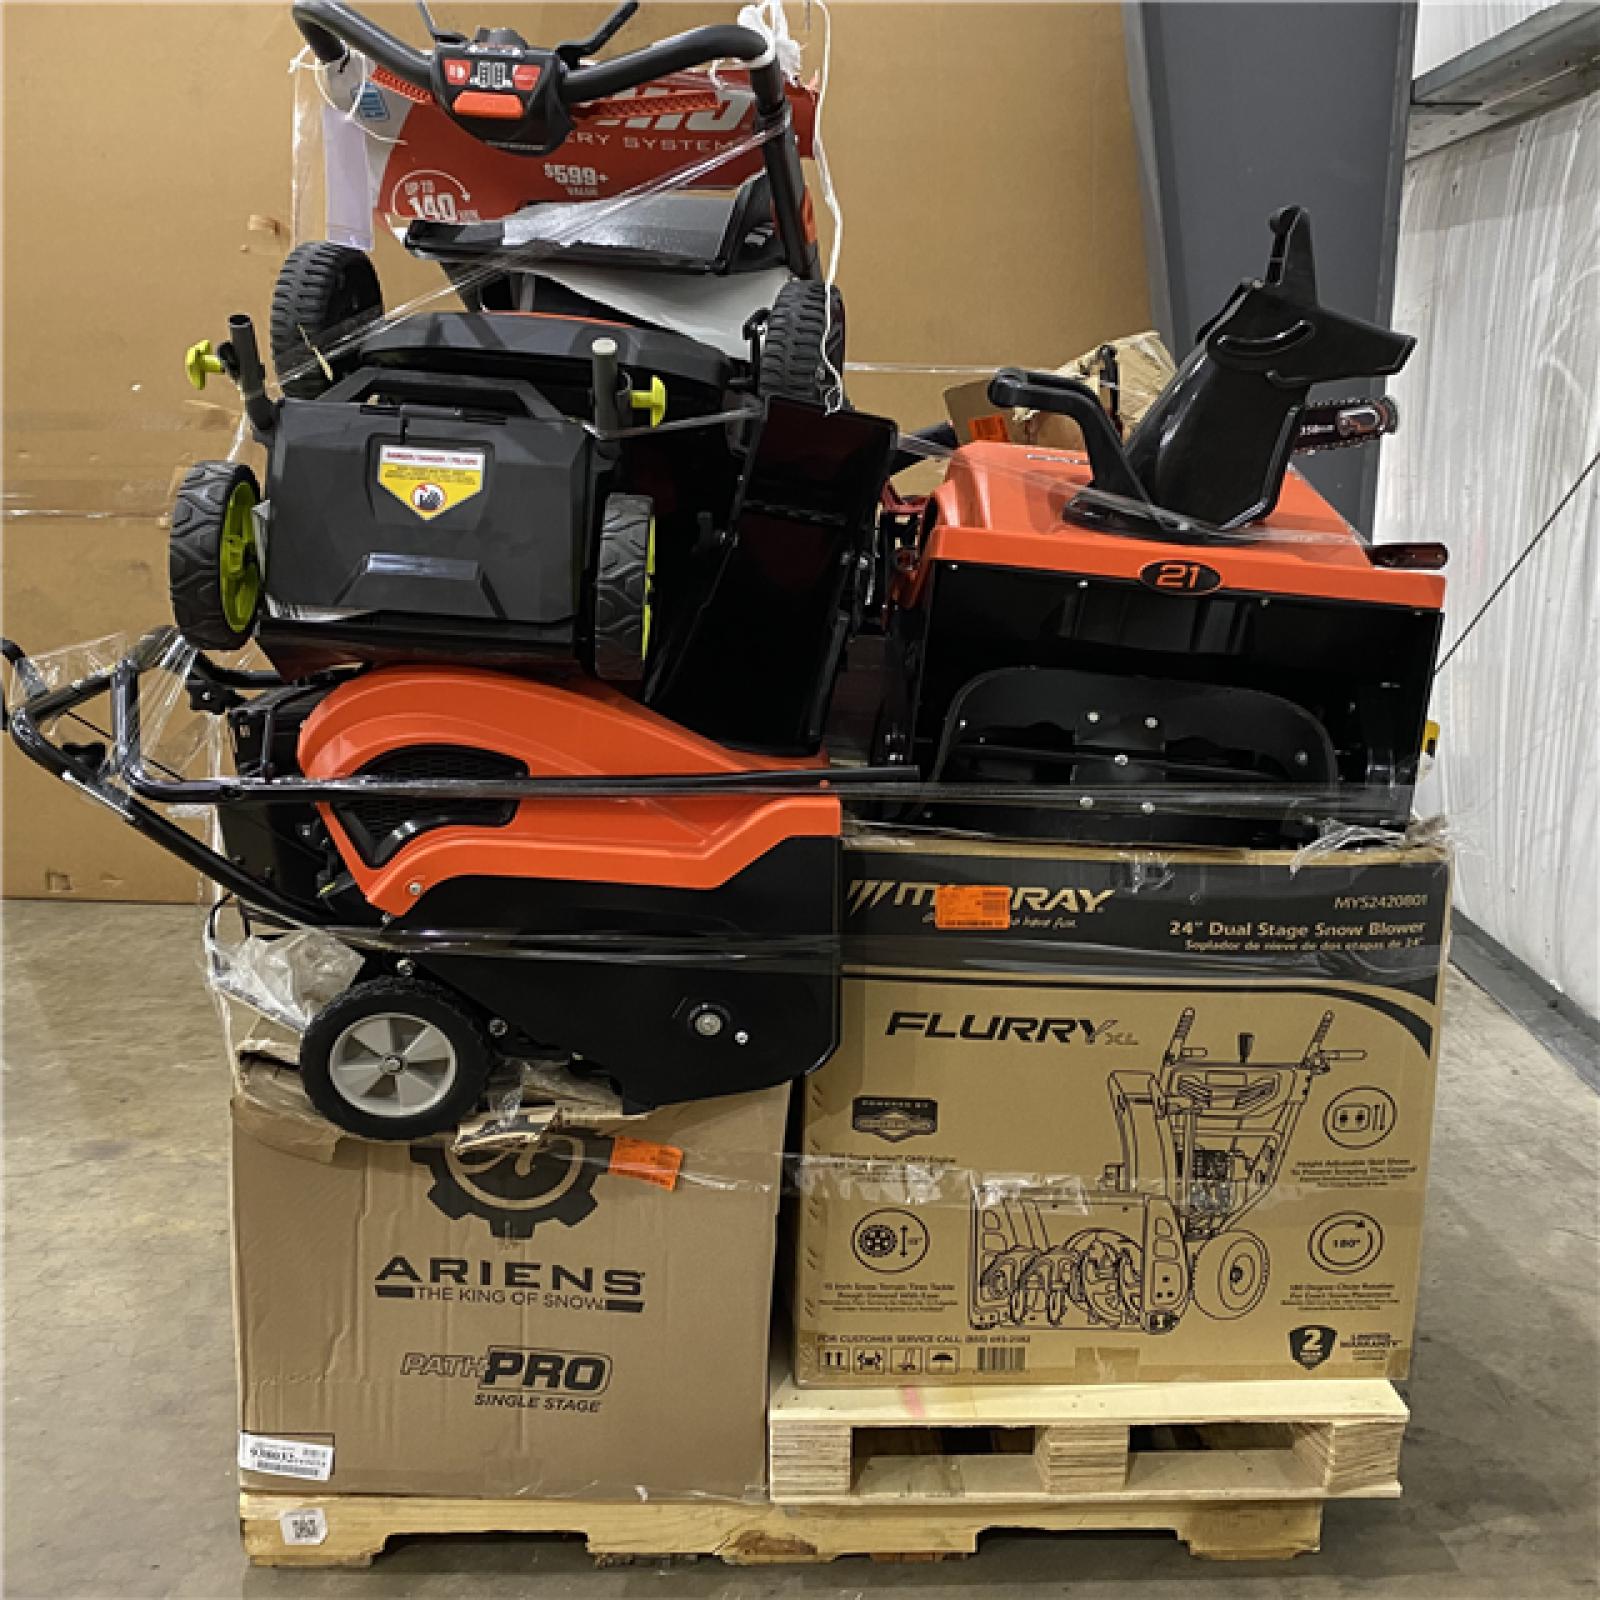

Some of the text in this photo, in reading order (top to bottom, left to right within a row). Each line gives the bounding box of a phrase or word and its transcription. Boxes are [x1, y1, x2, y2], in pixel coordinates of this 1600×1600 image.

[564, 130, 611, 146] ERY
[543, 162, 609, 186] $599+
[1156, 565, 1200, 588] 21
[893, 881, 1116, 914] MRAY
[1208, 921, 1252, 936] Dual
[1257, 921, 1310, 940] Stage
[1314, 921, 1364, 937] Snow
[1369, 920, 1426, 937] Blower
[885, 1010, 1118, 1045] FLURRY
[374, 1255, 643, 1296] ARIENS
[415, 1286, 606, 1310] THE KING OF SNOW
[1304, 1329, 1323, 1351] 2
[484, 1352, 606, 1391] PRO
[474, 1393, 602, 1413] SINGLE STAGE
